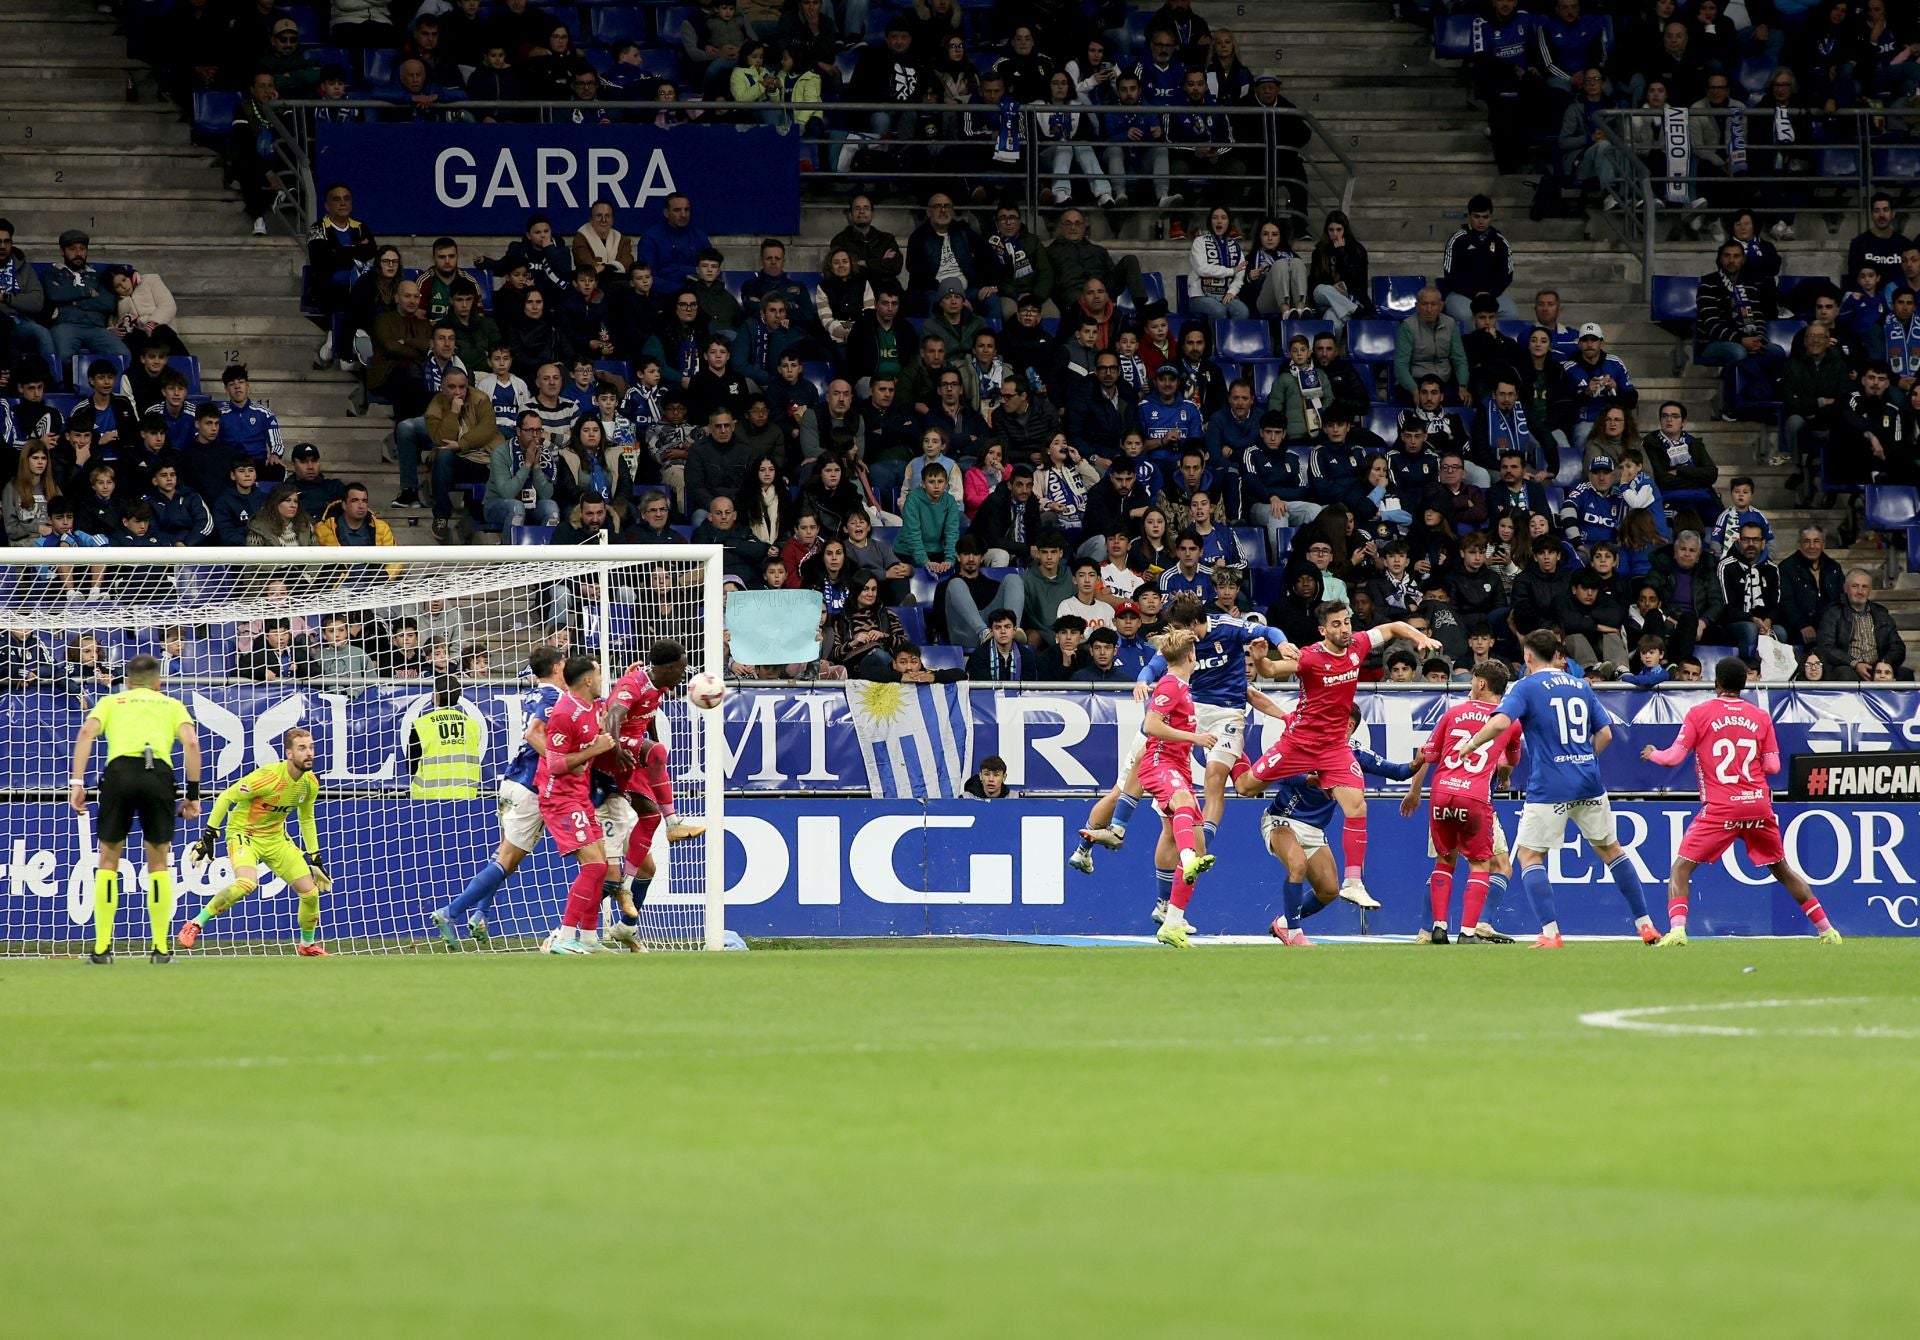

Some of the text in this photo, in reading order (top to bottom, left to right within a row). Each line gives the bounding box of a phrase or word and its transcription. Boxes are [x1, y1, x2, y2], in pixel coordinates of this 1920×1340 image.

[1275, 49, 1282, 60] 5
[1312, 93, 1320, 104] 4
[24, 126, 33, 138] 3
[1350, 136, 1359, 147] 3
[54, 171, 63, 183] 2
[434, 146, 678, 209] GARRA
[1389, 180, 1397, 191] 2
[90, 216, 95, 228] 1
[1864, 253, 1902, 264] Bench
[223, 350, 240, 362] 12
[1454, 711, 1490, 724] AARÓN
[1549, 697, 1589, 745] 19
[1711, 715, 1759, 732] ALASSAN
[438, 721, 465, 739] 047
[1443, 728, 1495, 773] 33
[1268, 752, 1283, 768] 4
[1712, 738, 1757, 784] 27
[1433, 806, 1468, 822] EAVE
[236, 833, 251, 846] 13
[650, 815, 1065, 905] DIGI
